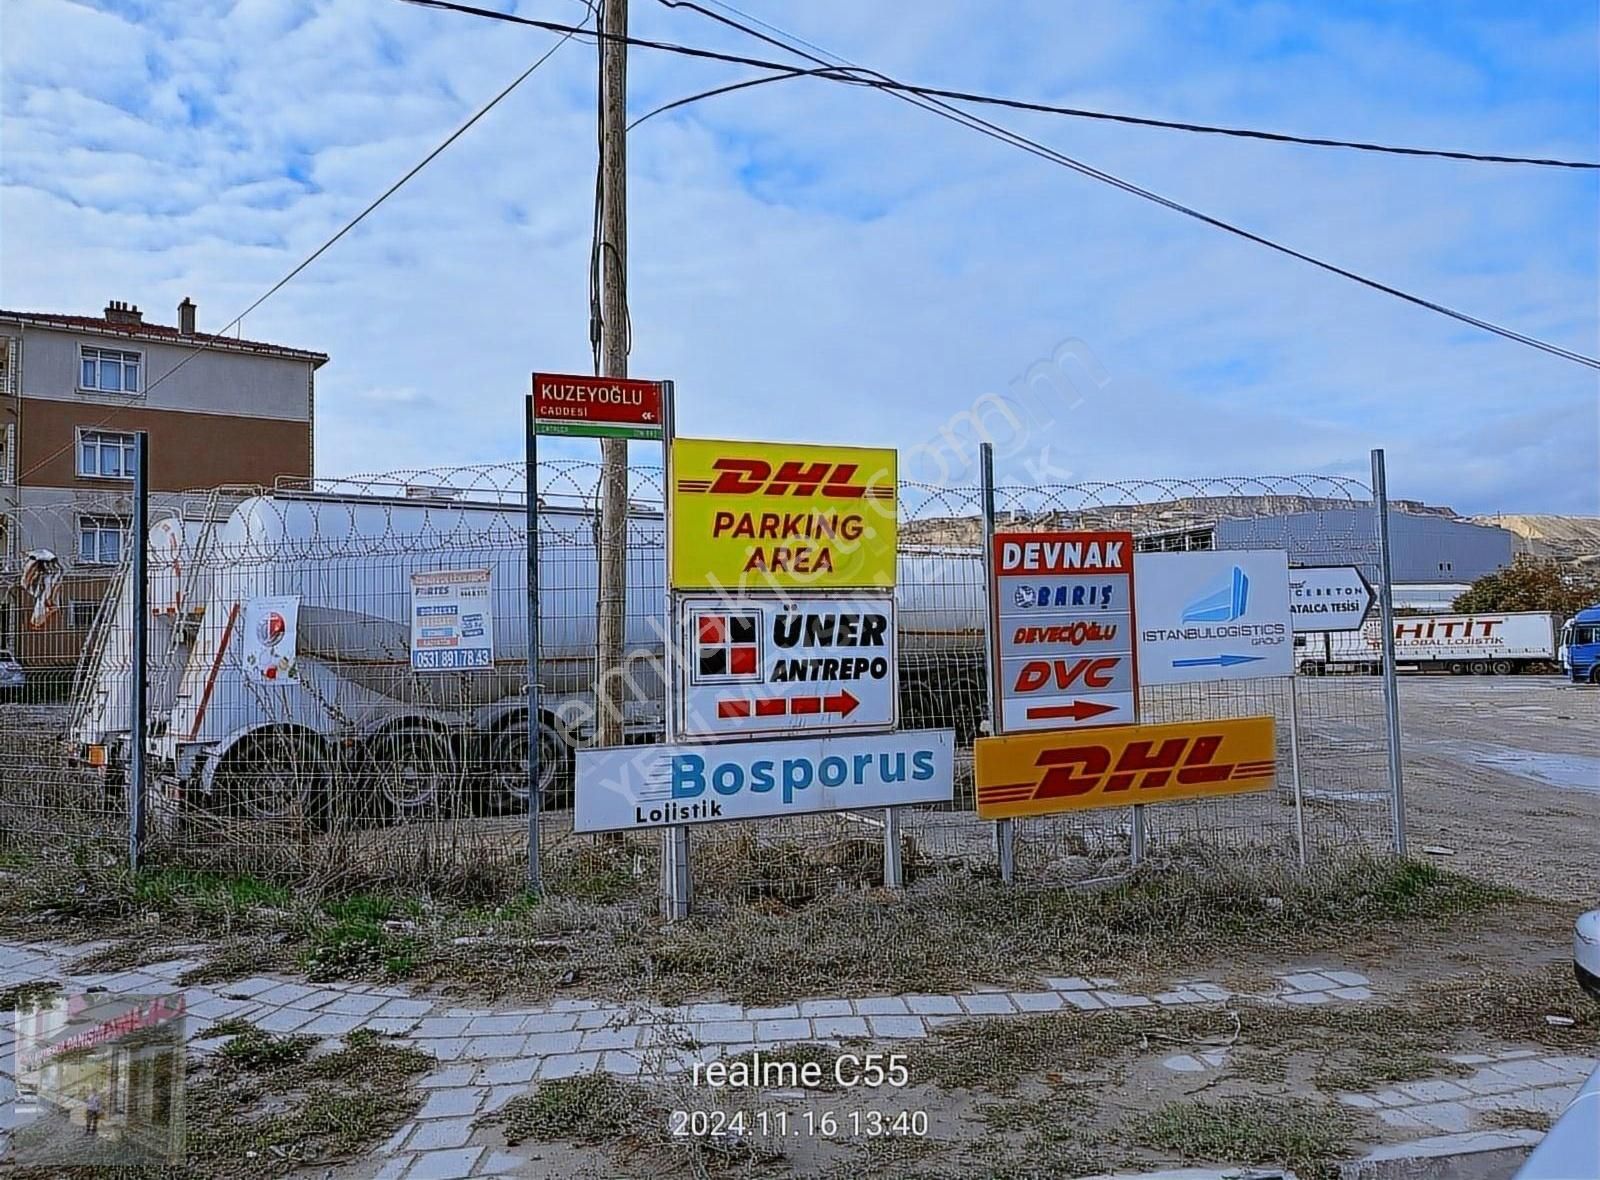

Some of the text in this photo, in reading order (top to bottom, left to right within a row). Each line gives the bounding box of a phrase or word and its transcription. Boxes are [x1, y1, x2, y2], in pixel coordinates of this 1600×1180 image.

[541, 384, 643, 405] KUZEYOĞLU
[540, 405, 588, 417] CADDESİ
[708, 458, 868, 498] DHL
[713, 511, 864, 541] PARKING
[743, 546, 834, 573] AREA
[1002, 541, 1124, 570] DEVNAK
[1037, 584, 1113, 610] BARIŞ
[1289, 600, 1360, 613] ATALCA TESİSİ
[773, 604, 888, 649] ÜNER
[1395, 618, 1503, 639] HİTİT
[1251, 636, 1285, 646] GROUP
[1394, 638, 1444, 647] GLOBAL
[770, 657, 888, 683] ANTREPO
[1014, 657, 1121, 692] DVC
[670, 749, 936, 803] Bosporus
[1031, 735, 1235, 800] DHL
[636, 800, 722, 823] Lojistik
